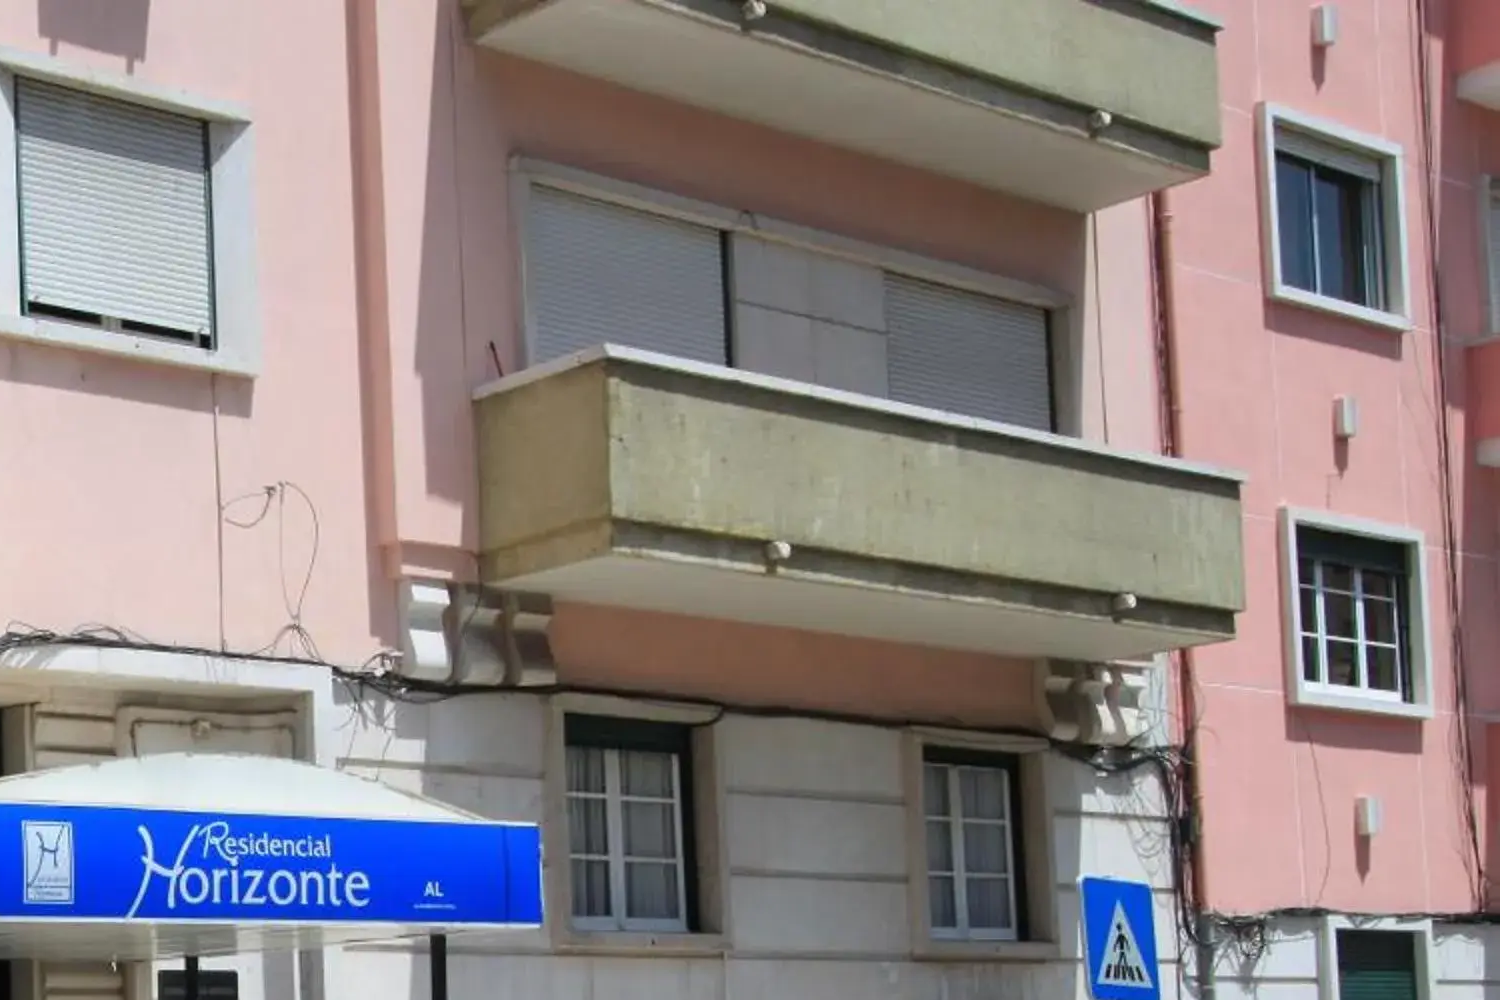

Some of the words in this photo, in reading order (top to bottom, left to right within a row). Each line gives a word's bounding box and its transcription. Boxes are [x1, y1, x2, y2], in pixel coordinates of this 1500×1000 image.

[197, 820, 332, 866] Residencial
[126, 823, 371, 918] Horizonte
[423, 880, 445, 897] AL
